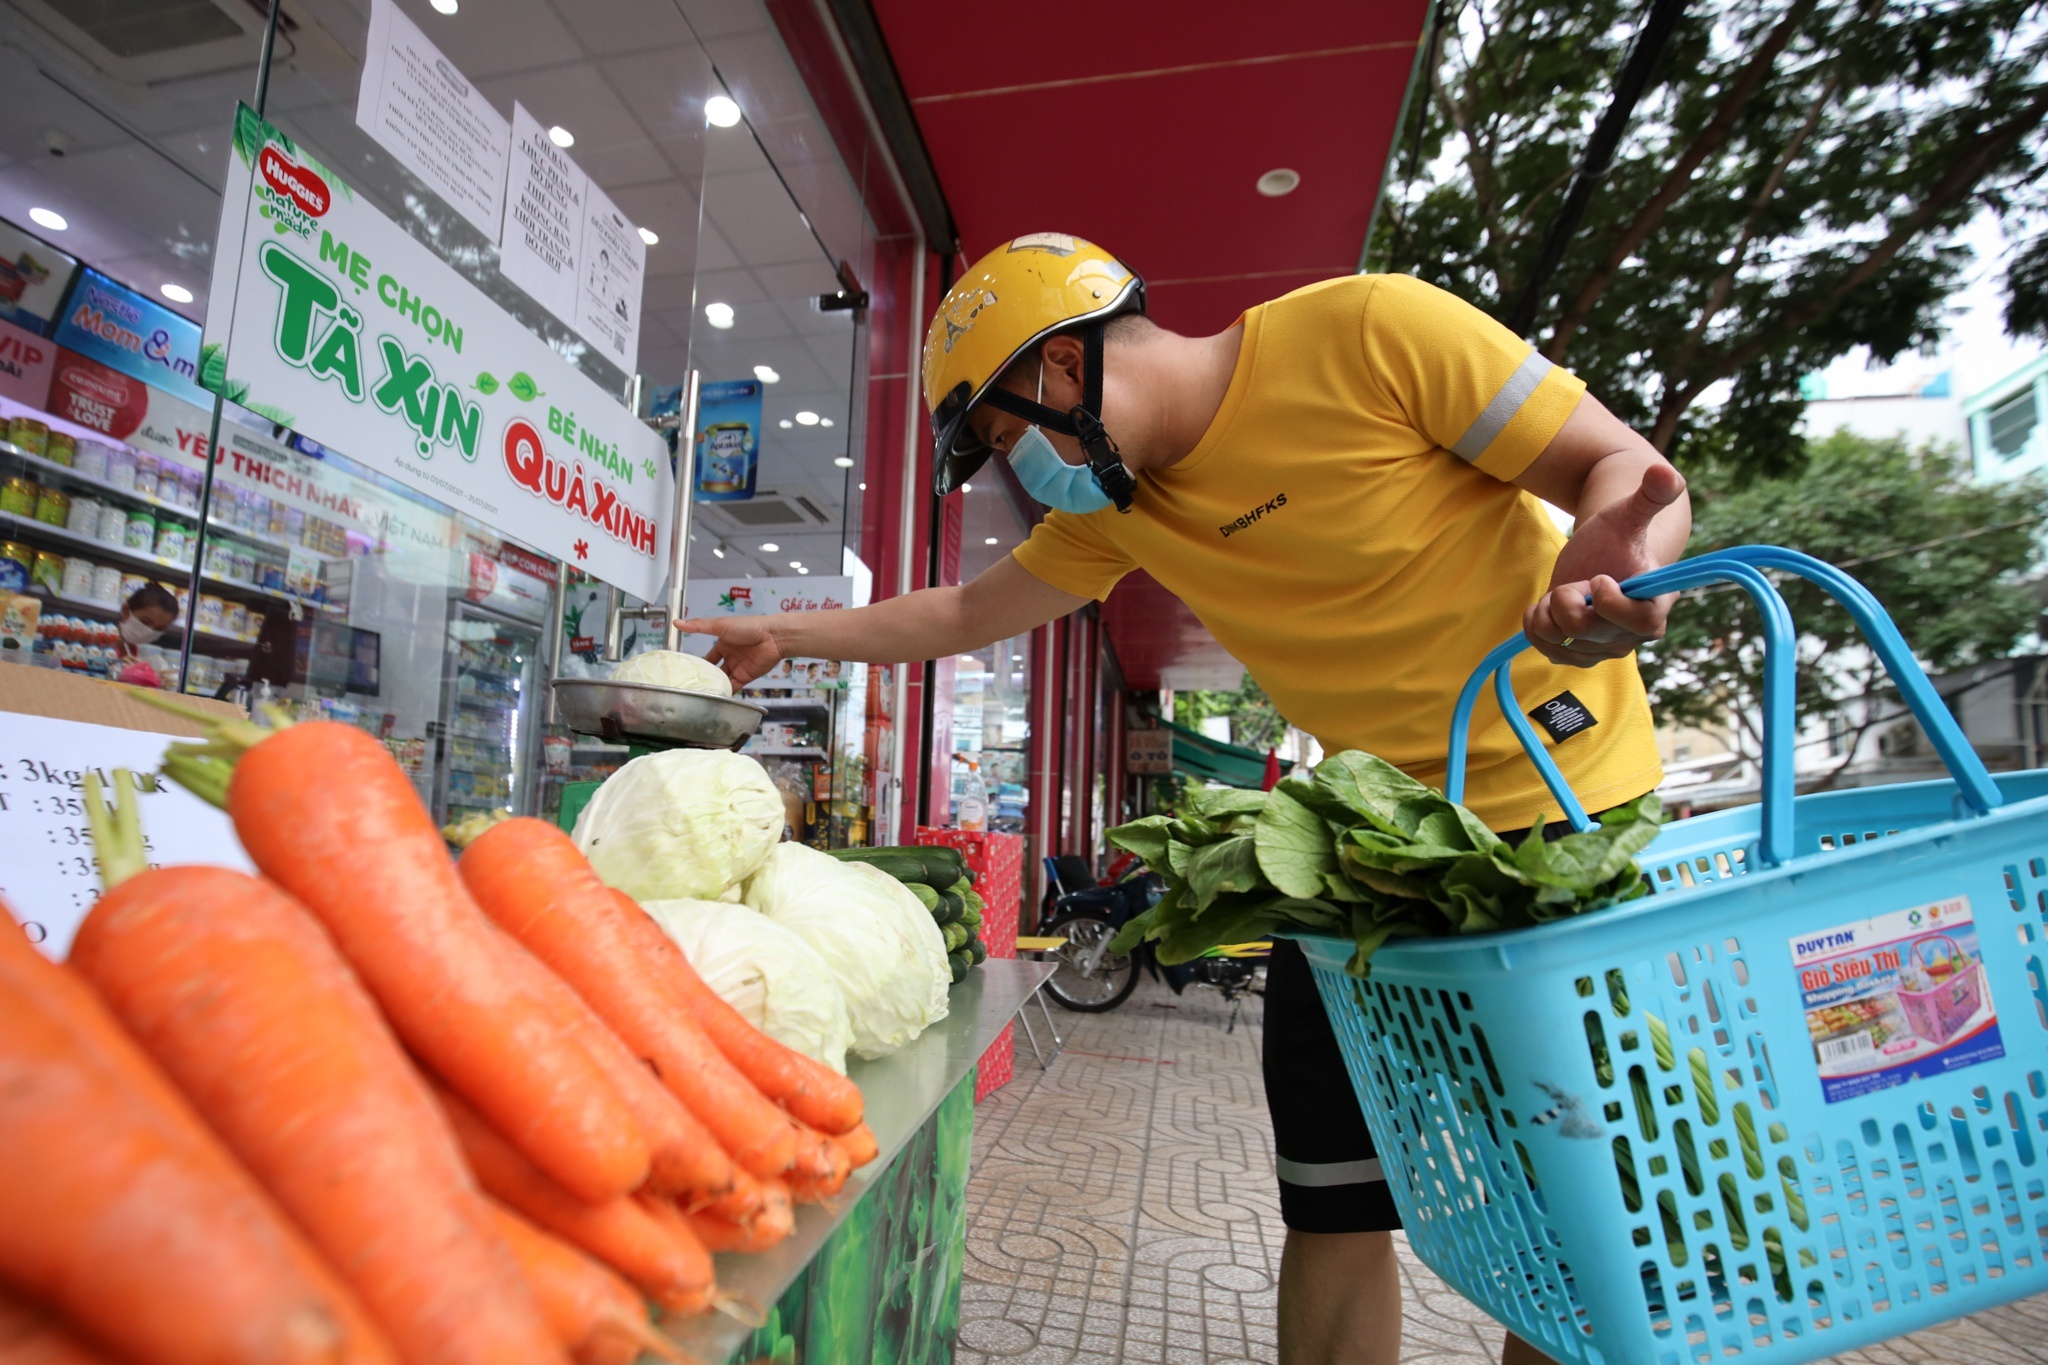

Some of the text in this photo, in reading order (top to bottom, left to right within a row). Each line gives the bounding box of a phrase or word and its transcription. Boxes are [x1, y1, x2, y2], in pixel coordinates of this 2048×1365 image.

[265, 156, 324, 212] HUGGIES
[265, 186, 318, 232] nature
[319, 229, 464, 355] MẸ CHỌN
[72, 303, 141, 353] Mom
[143, 328, 171, 367] &
[262, 244, 482, 461] TÃ XỊN
[69, 391, 116, 420] TRUST
[74, 407, 111, 433] LOVE
[579, 427, 633, 485] NHẬN
[591, 478, 656, 558] XINH
[1795, 930, 1855, 955] DUYTAN
[1831, 953, 1872, 984] Siêu
